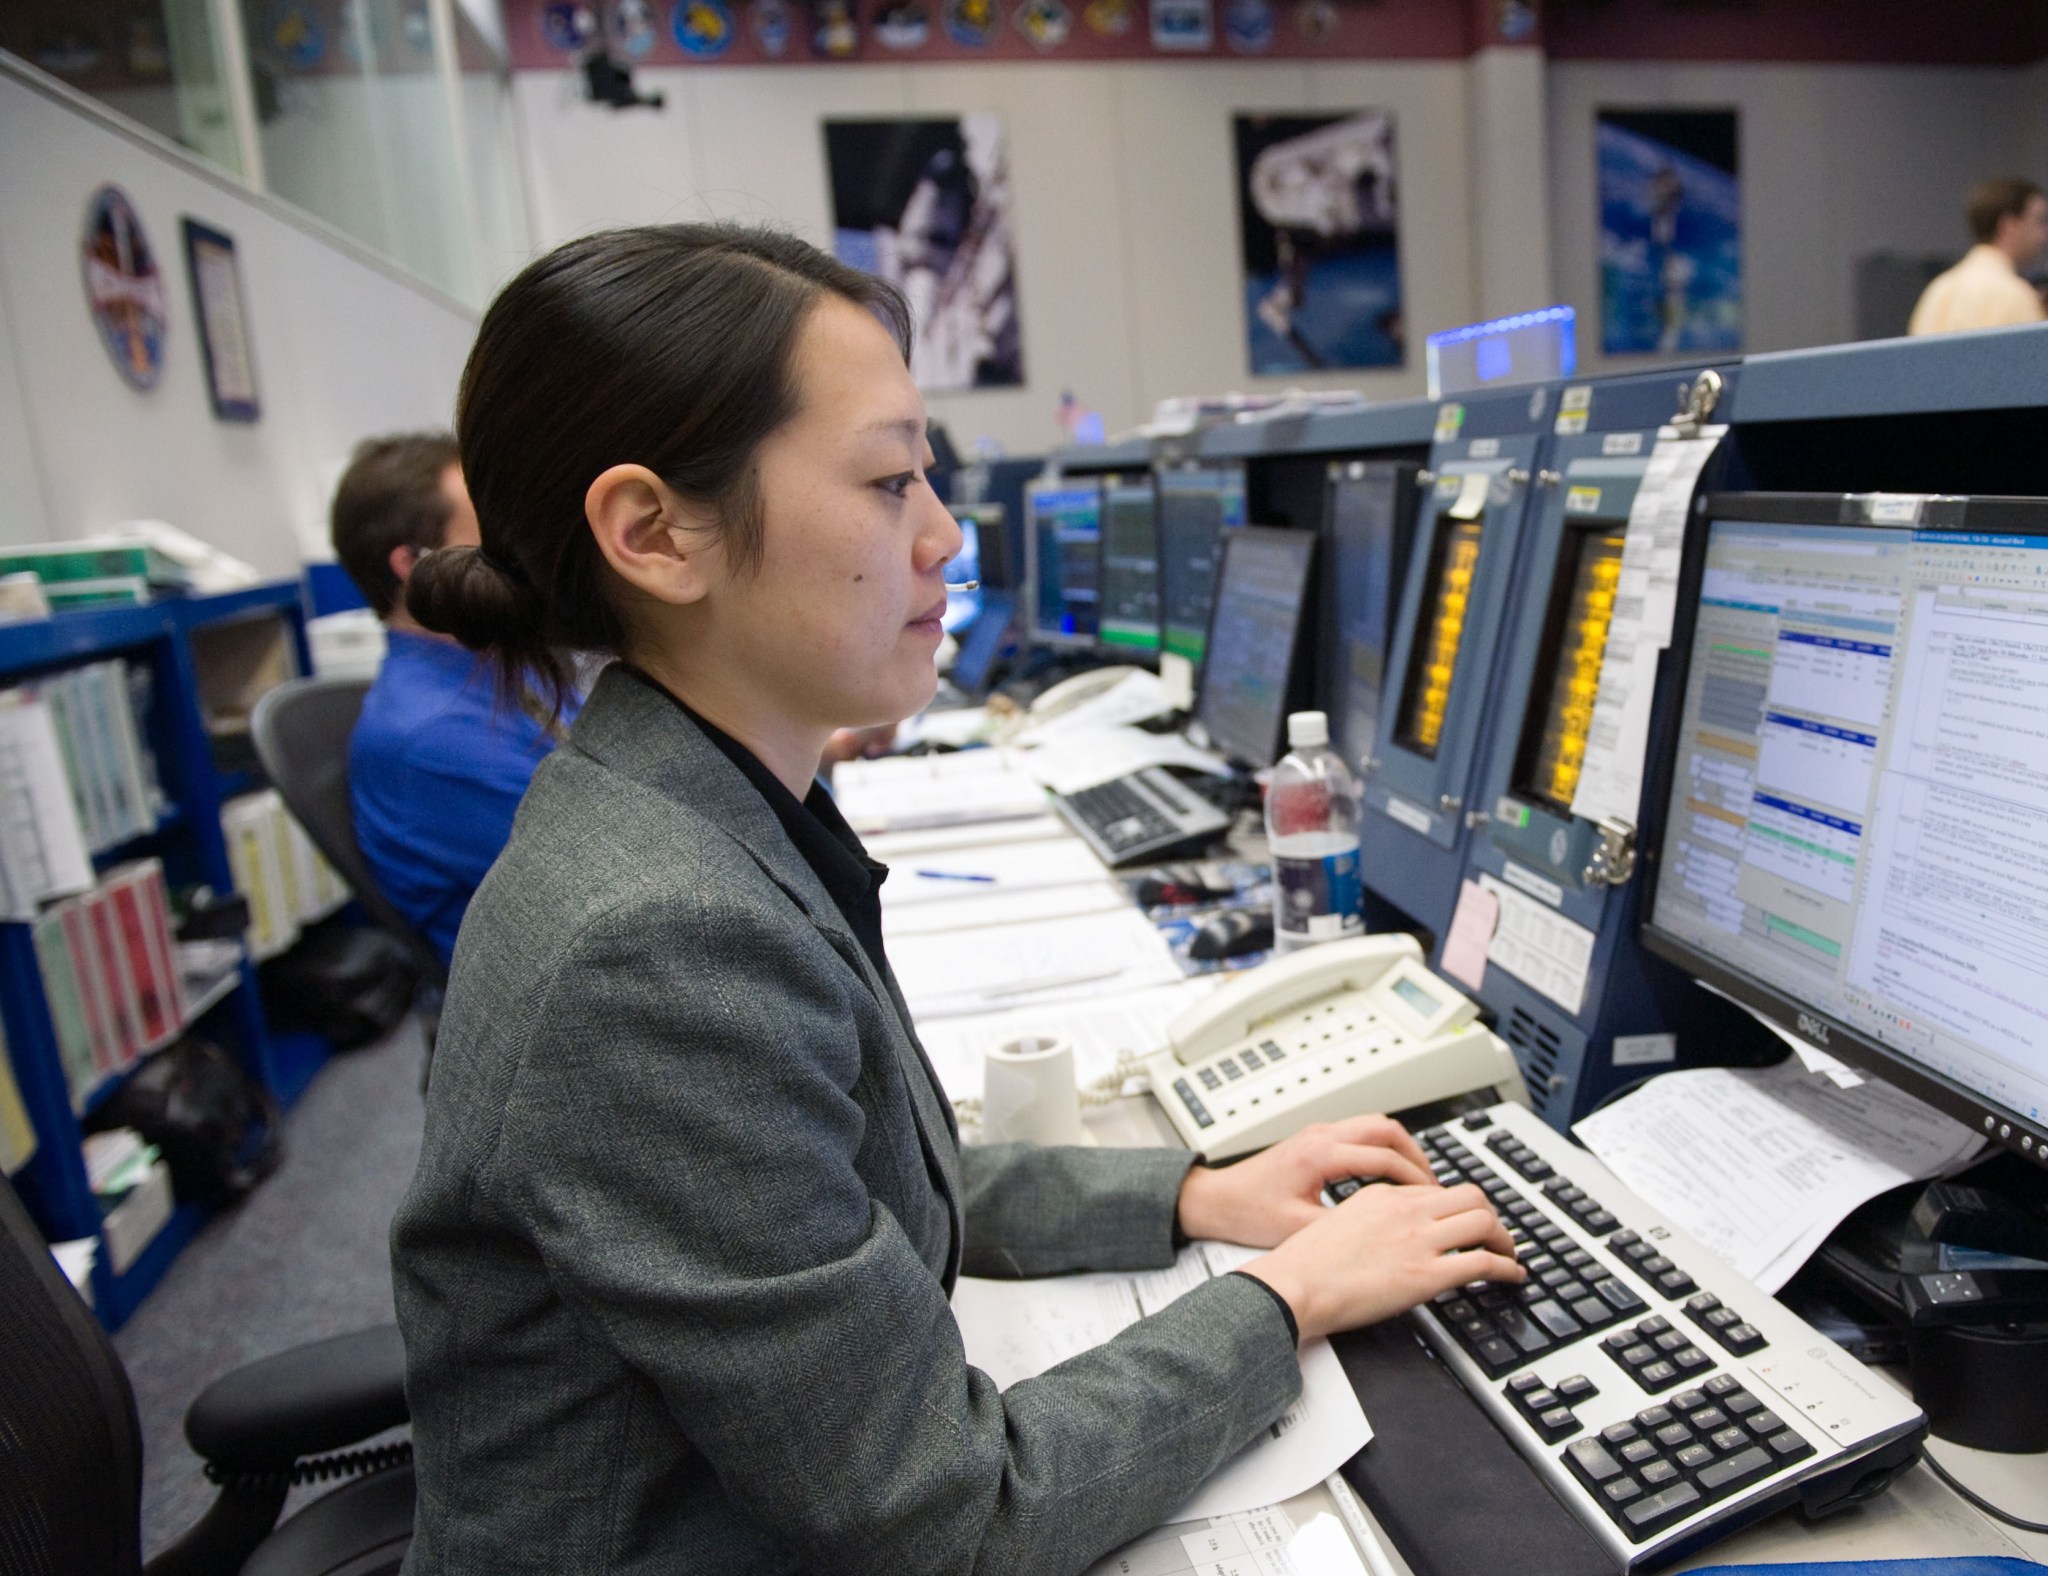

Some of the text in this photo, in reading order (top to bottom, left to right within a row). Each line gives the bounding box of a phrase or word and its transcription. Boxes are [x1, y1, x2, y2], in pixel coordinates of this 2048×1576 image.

[1797, 1013, 1830, 1045] DELL
[1727, 1429, 1739, 1438] 9
[1691, 1447, 1703, 1455] 6
